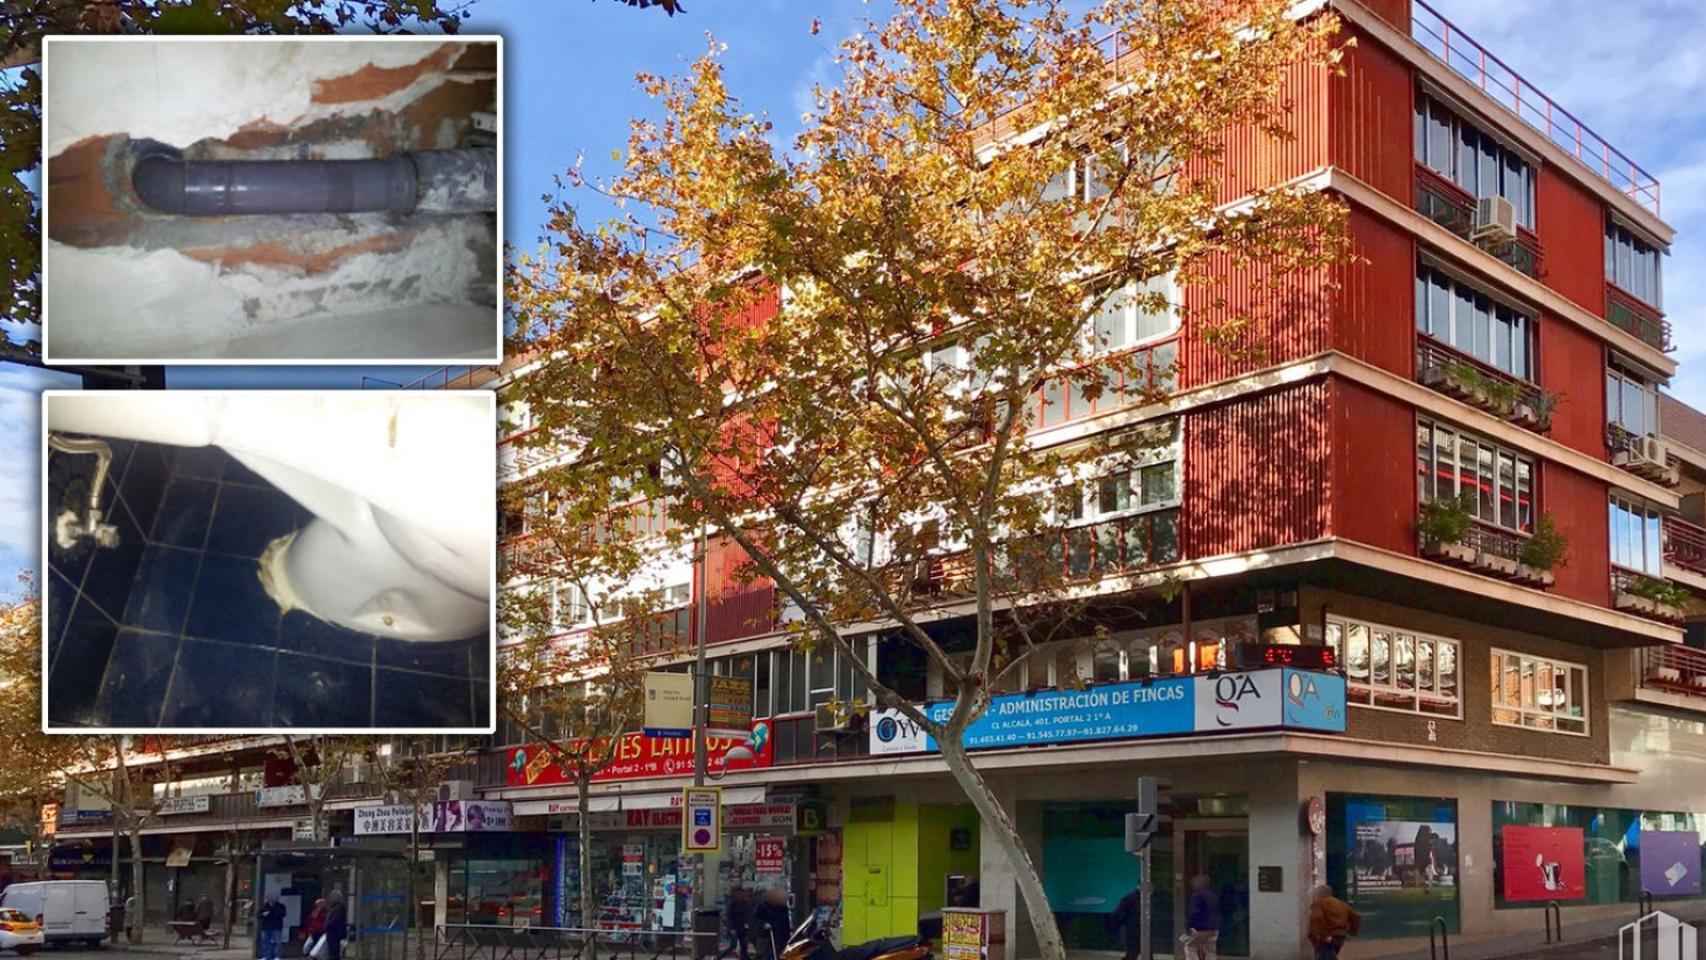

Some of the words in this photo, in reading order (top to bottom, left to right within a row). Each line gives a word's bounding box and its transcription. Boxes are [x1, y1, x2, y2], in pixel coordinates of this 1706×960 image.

[1000, 691, 1109, 715] ADMINISTRACIÓN
[1112, 690, 1129, 705] DE
[1133, 685, 1184, 703] FINCAS
[1053, 714, 1085, 725] PORTAL
[1104, 713, 1112, 721] A
[627, 810, 650, 827] RAY
[804, 809, 818, 828] B
